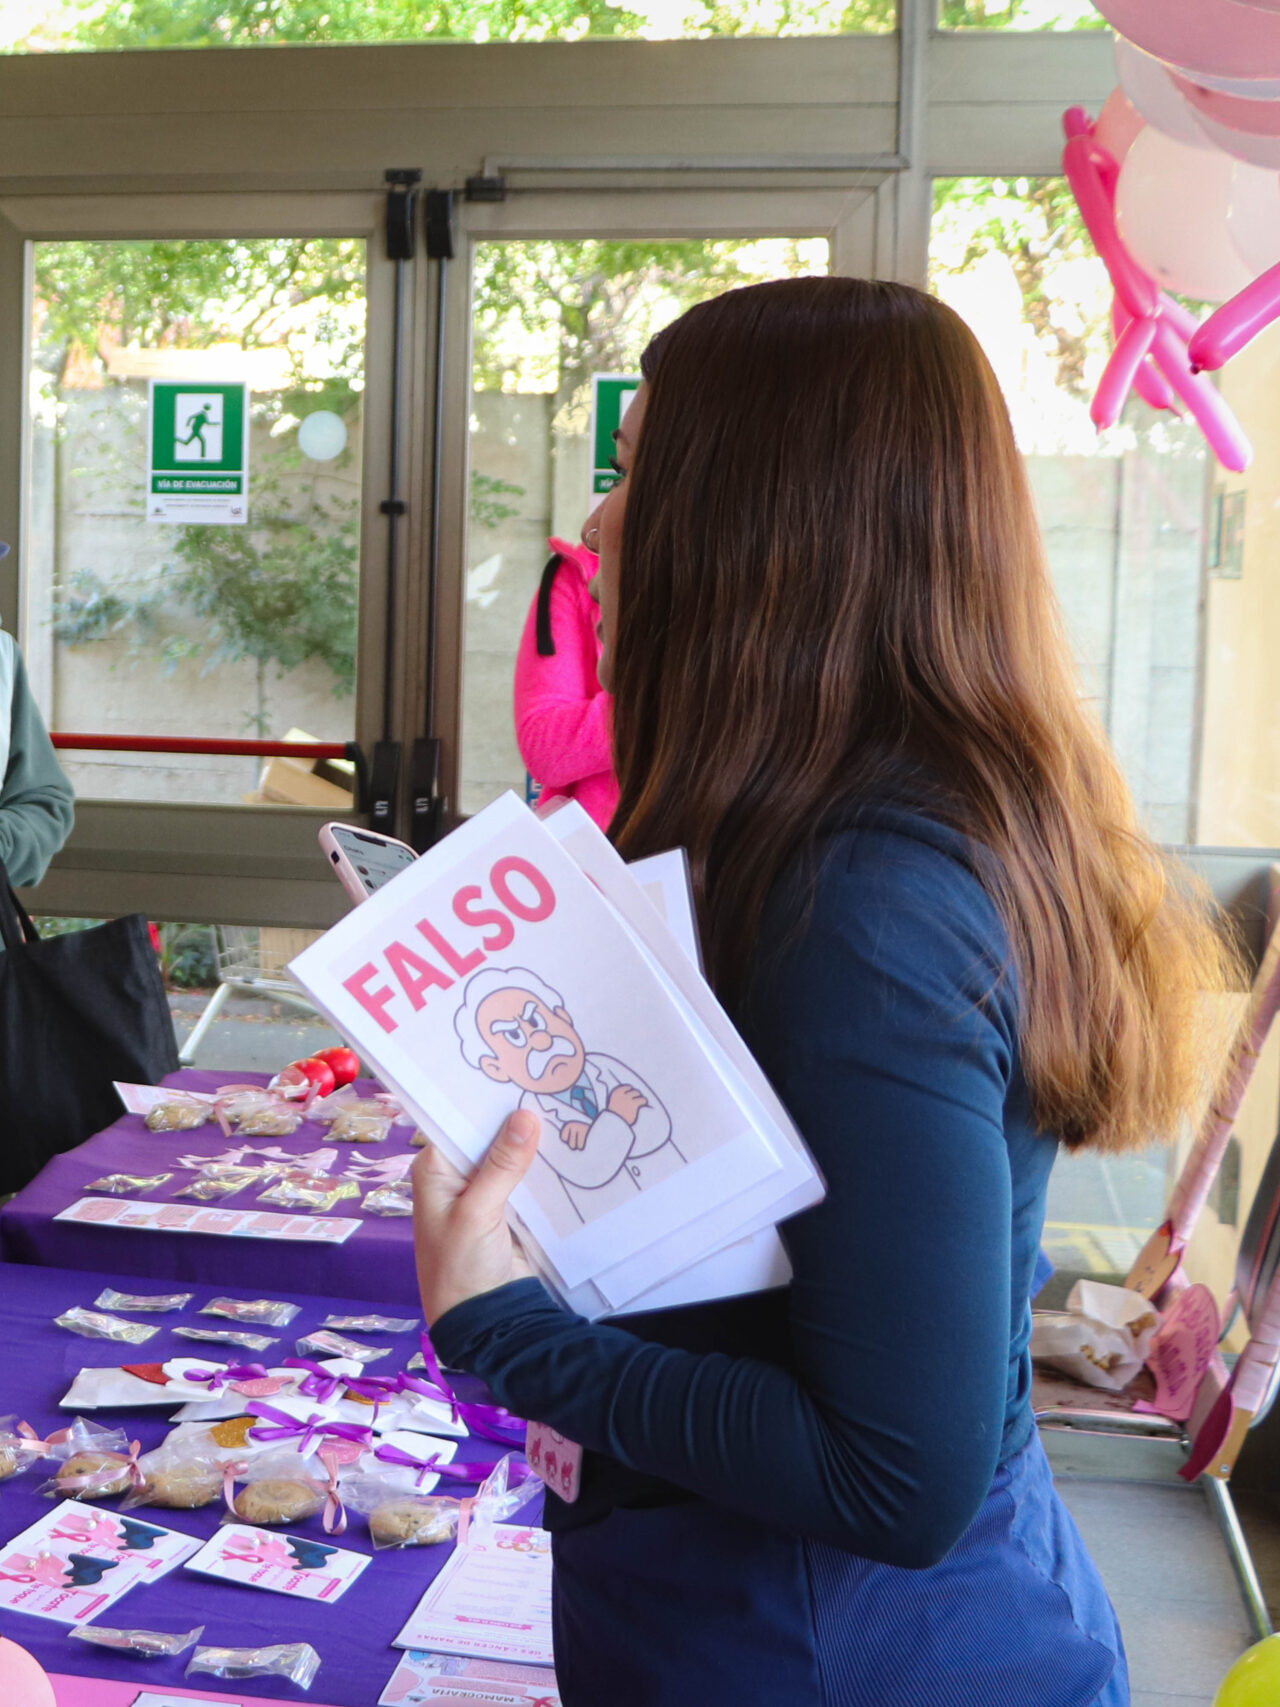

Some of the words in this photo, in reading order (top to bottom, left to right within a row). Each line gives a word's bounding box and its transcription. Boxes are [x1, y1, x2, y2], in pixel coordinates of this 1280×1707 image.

[172, 480, 185, 489] DE
[185, 478, 238, 490] EVACUACIÓN
[342, 855, 557, 1034] FALSO
